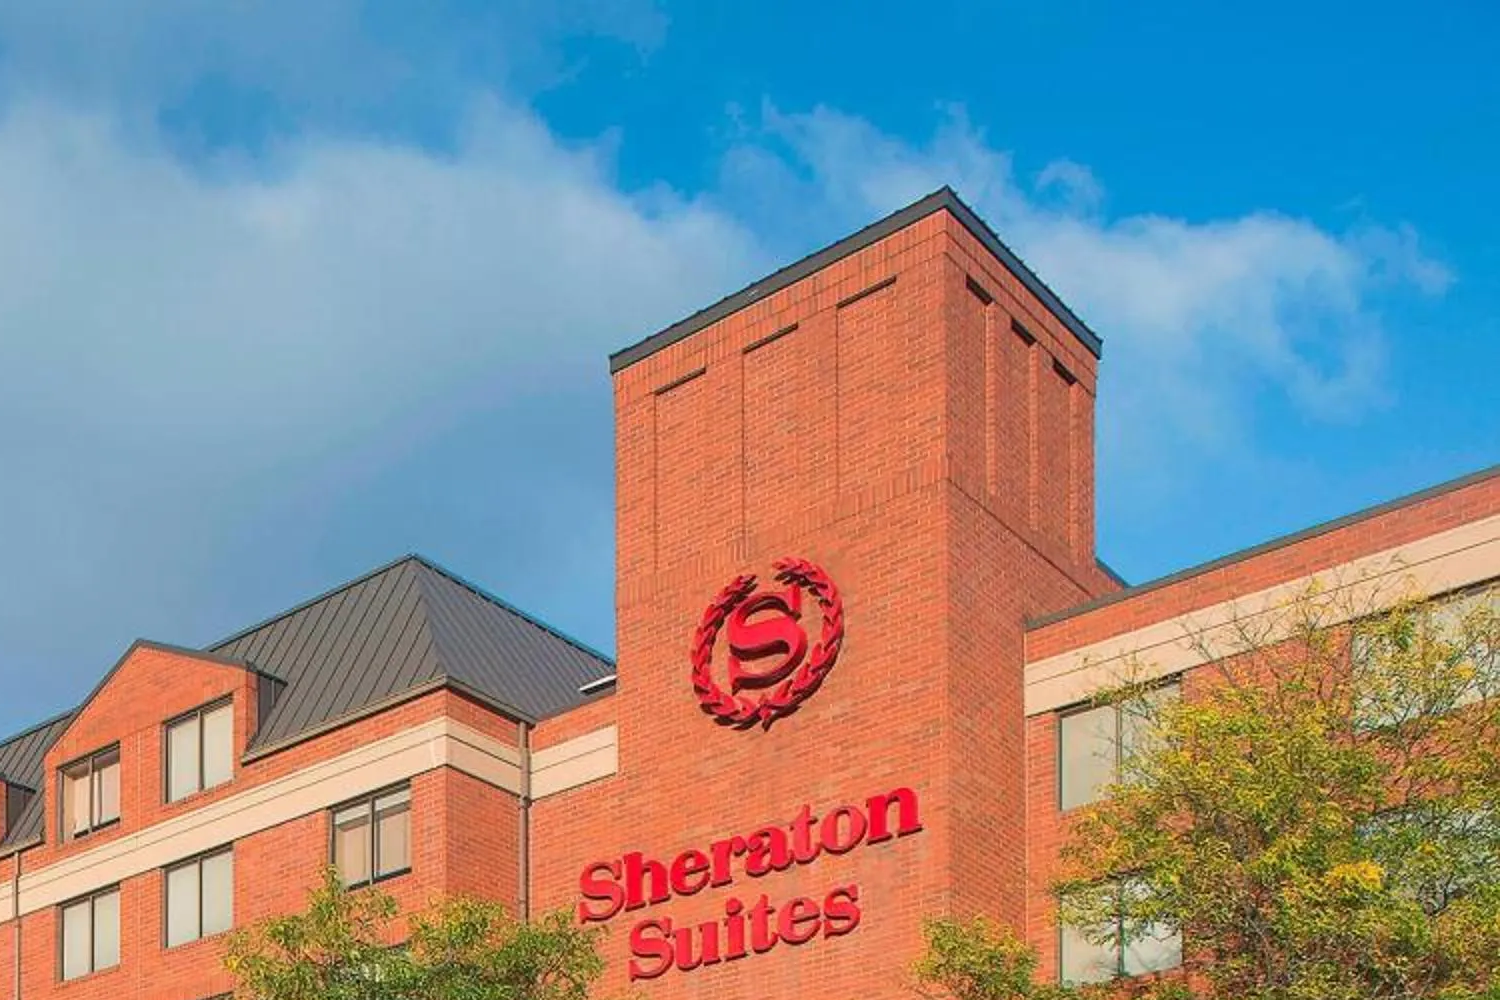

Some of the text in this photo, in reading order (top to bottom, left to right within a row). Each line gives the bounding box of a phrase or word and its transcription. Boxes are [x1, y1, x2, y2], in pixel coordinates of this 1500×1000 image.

[728, 582, 807, 694] S
[579, 786, 922, 923] Sheraton
[628, 884, 861, 982] Suites
